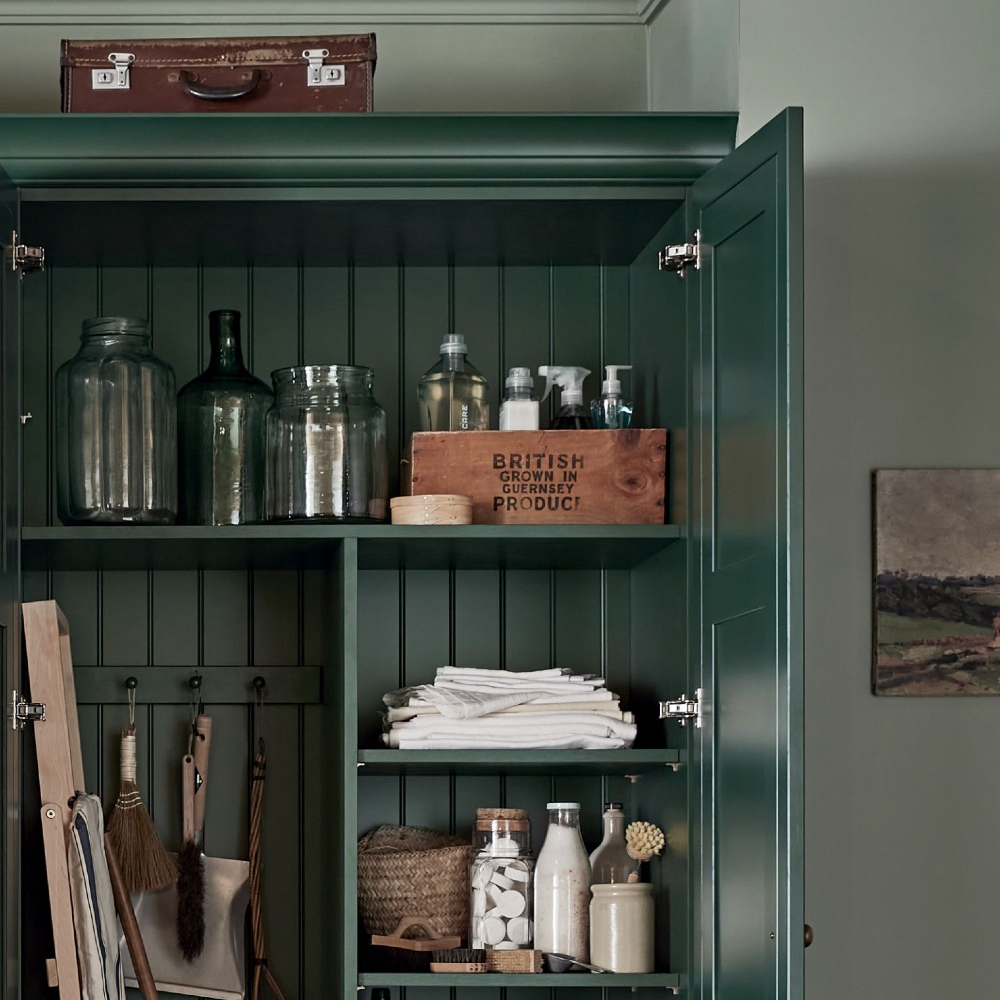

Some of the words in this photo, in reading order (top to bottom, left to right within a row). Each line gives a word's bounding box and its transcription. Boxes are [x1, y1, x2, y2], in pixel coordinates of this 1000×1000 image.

[461, 404, 469, 430] CARE
[493, 453, 584, 469] BRITISH
[500, 470, 554, 482] GROWN
[563, 470, 577, 482] IN
[502, 483, 574, 494] GUERNSEY
